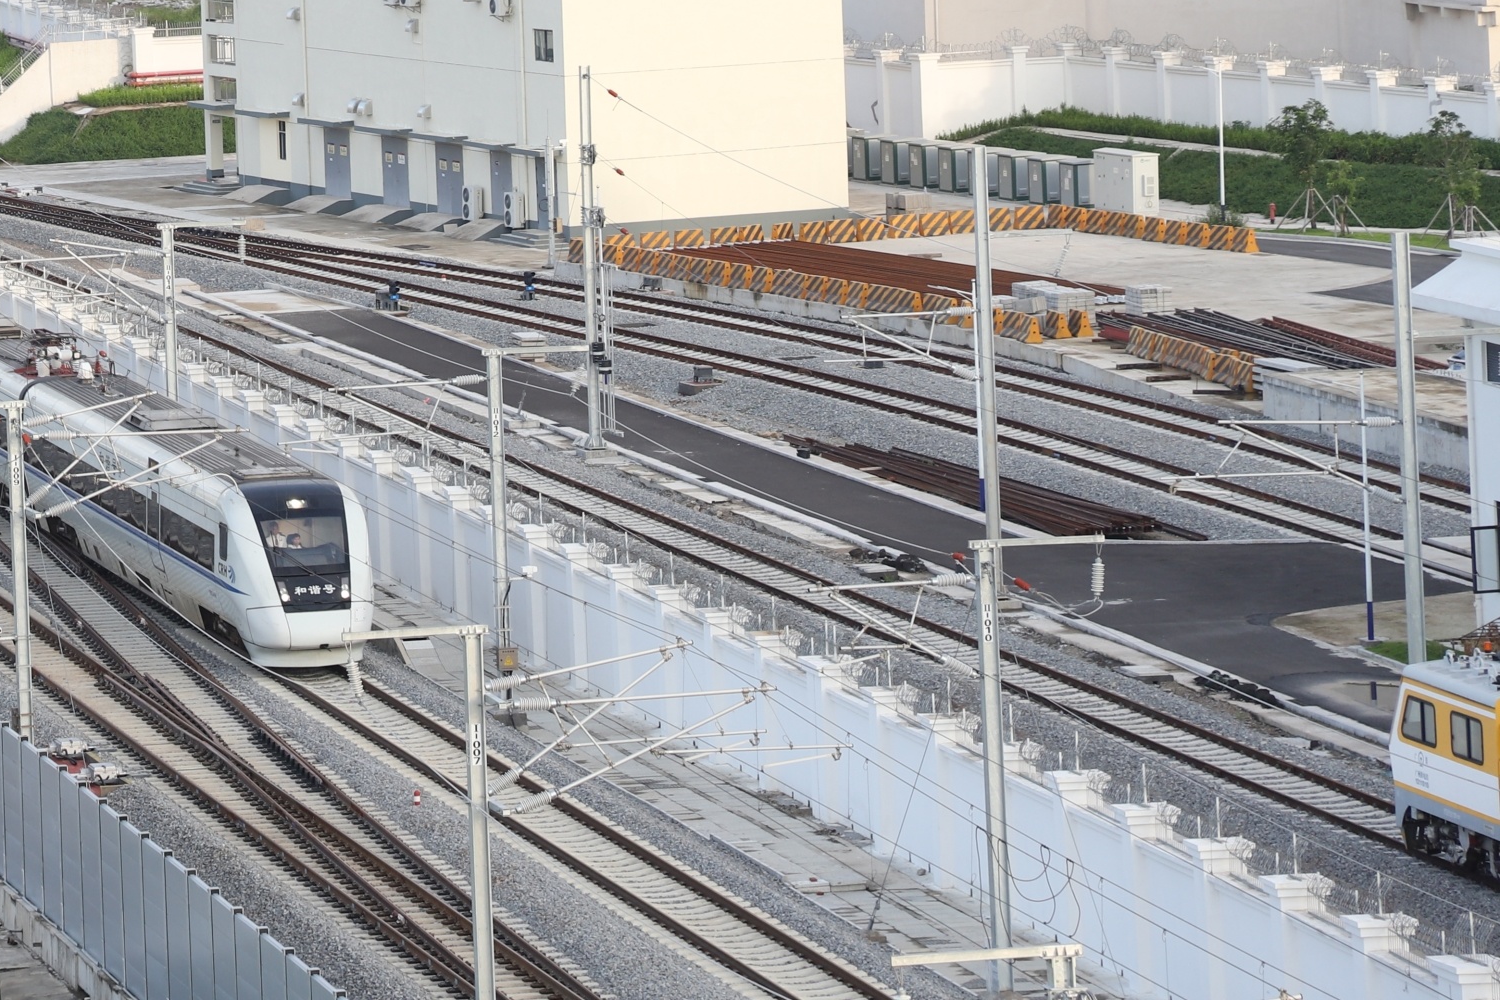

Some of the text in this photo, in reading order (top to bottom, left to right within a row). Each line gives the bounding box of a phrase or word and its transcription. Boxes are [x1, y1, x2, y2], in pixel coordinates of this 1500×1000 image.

[217, 562, 228, 578] CRH
[294, 584, 336, 596] 和谐号
[472, 724, 481, 765] I-007
